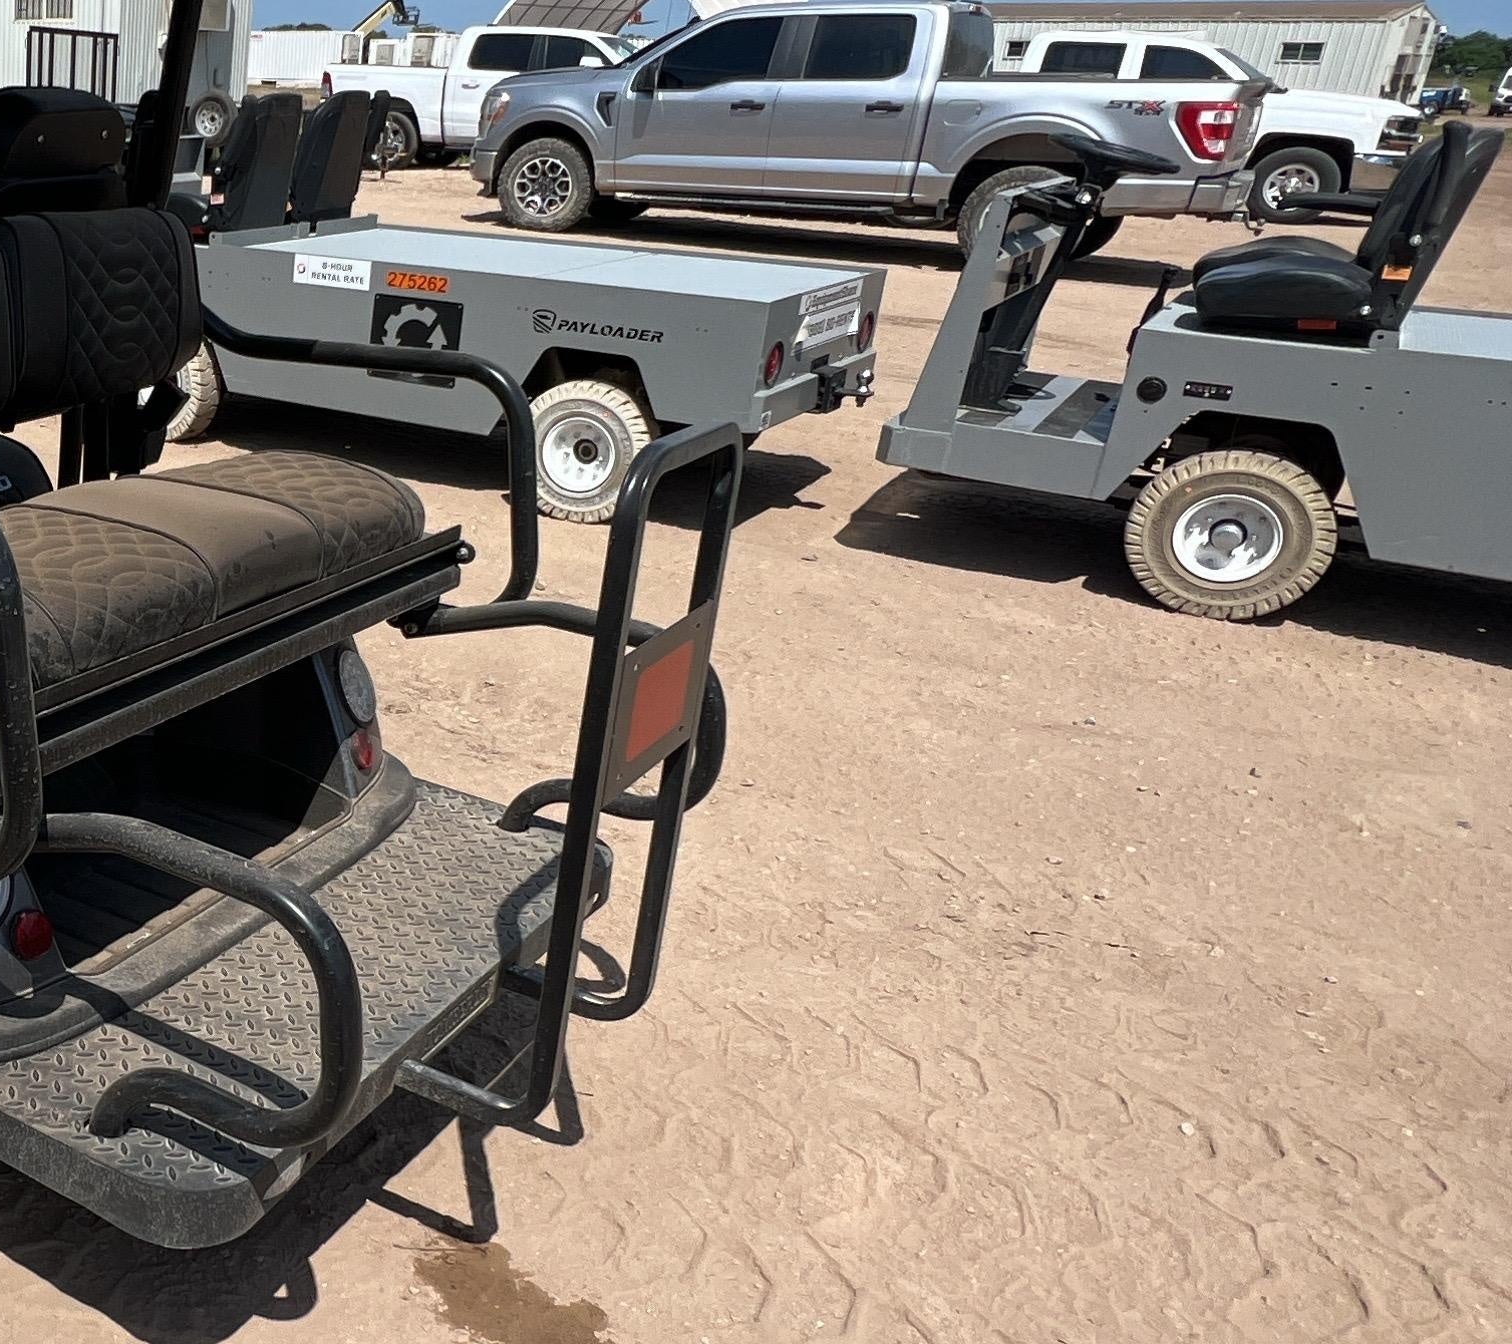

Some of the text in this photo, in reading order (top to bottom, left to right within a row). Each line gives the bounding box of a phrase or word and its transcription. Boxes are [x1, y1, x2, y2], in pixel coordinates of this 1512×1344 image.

[321, 261, 353, 273] 8-HOUR
[311, 271, 364, 285] RENTAL RATE
[387, 271, 448, 293] 275262
[557, 319, 664, 343] PAYLOADER
